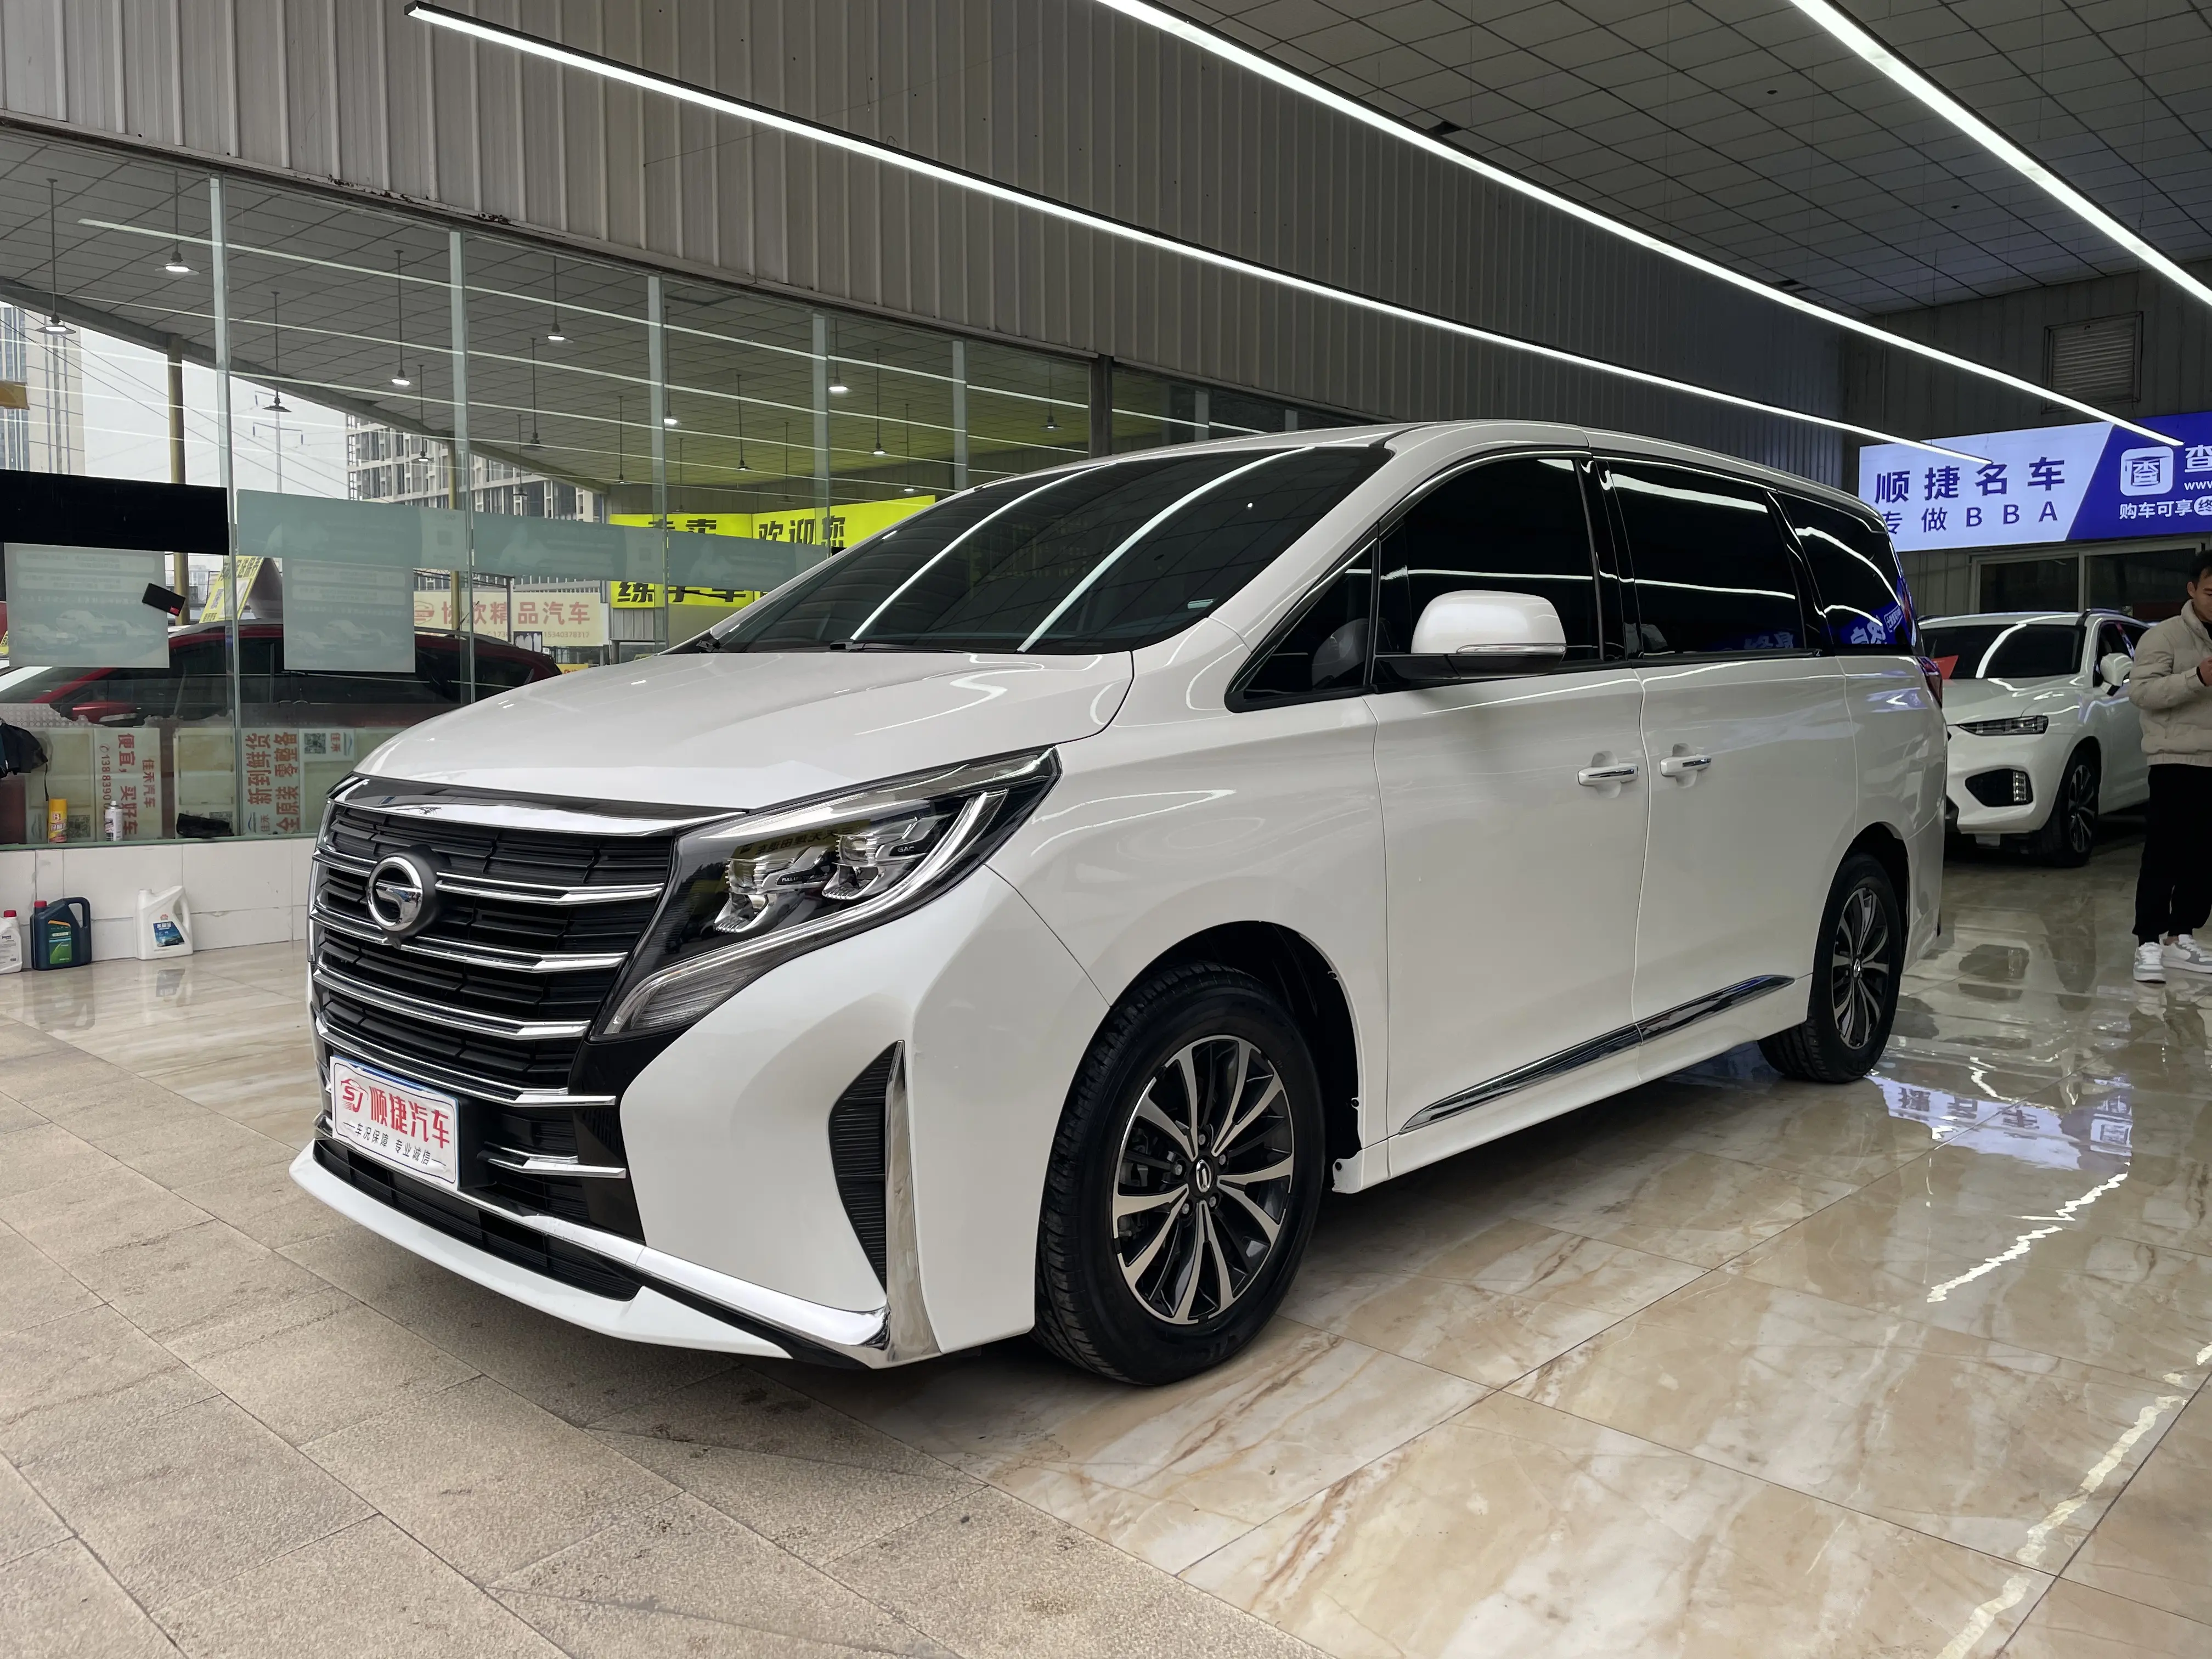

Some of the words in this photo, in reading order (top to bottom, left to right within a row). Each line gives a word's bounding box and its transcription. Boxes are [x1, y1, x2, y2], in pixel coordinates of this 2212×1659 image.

[1875, 456, 2065, 505] 顺捷名车
[245, 732, 272, 805] 新到鲜货
[370, 1087, 450, 1149] 顺捷汽车
[394, 1138, 431, 1166] 专业诚信
